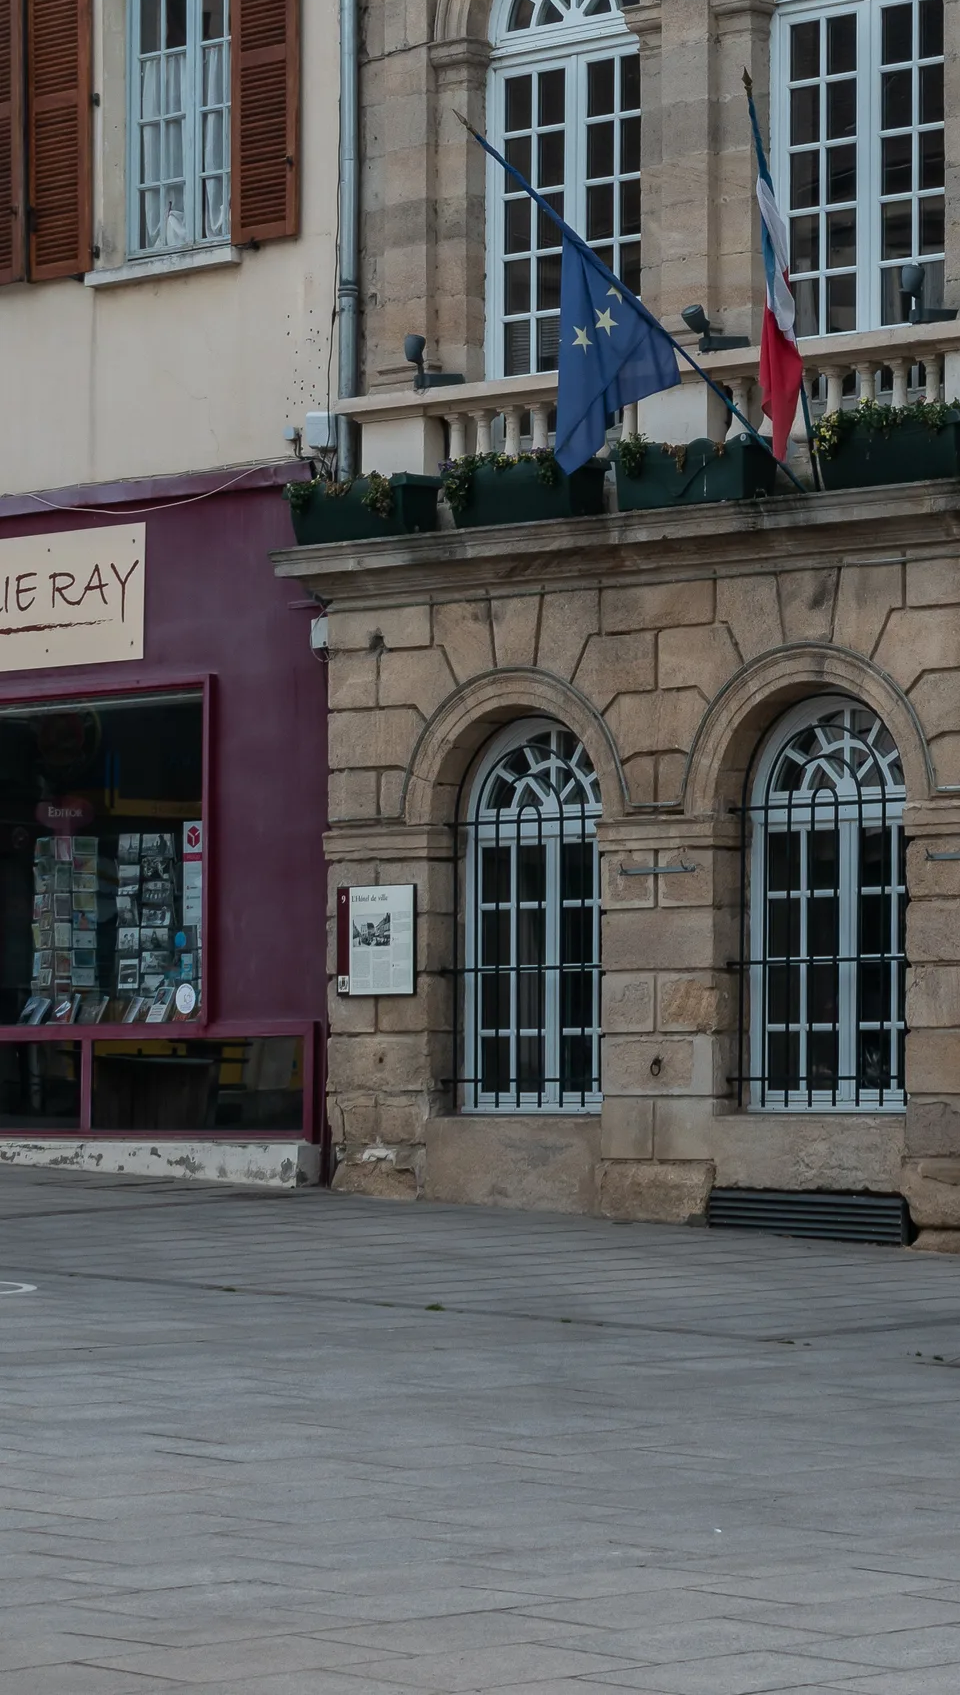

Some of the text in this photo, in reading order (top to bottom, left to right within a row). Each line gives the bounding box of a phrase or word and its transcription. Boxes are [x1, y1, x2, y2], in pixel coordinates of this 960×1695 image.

[0, 559, 140, 623] IE RAY
[341, 894, 346, 904] 9
[370, 893, 377, 902] de
